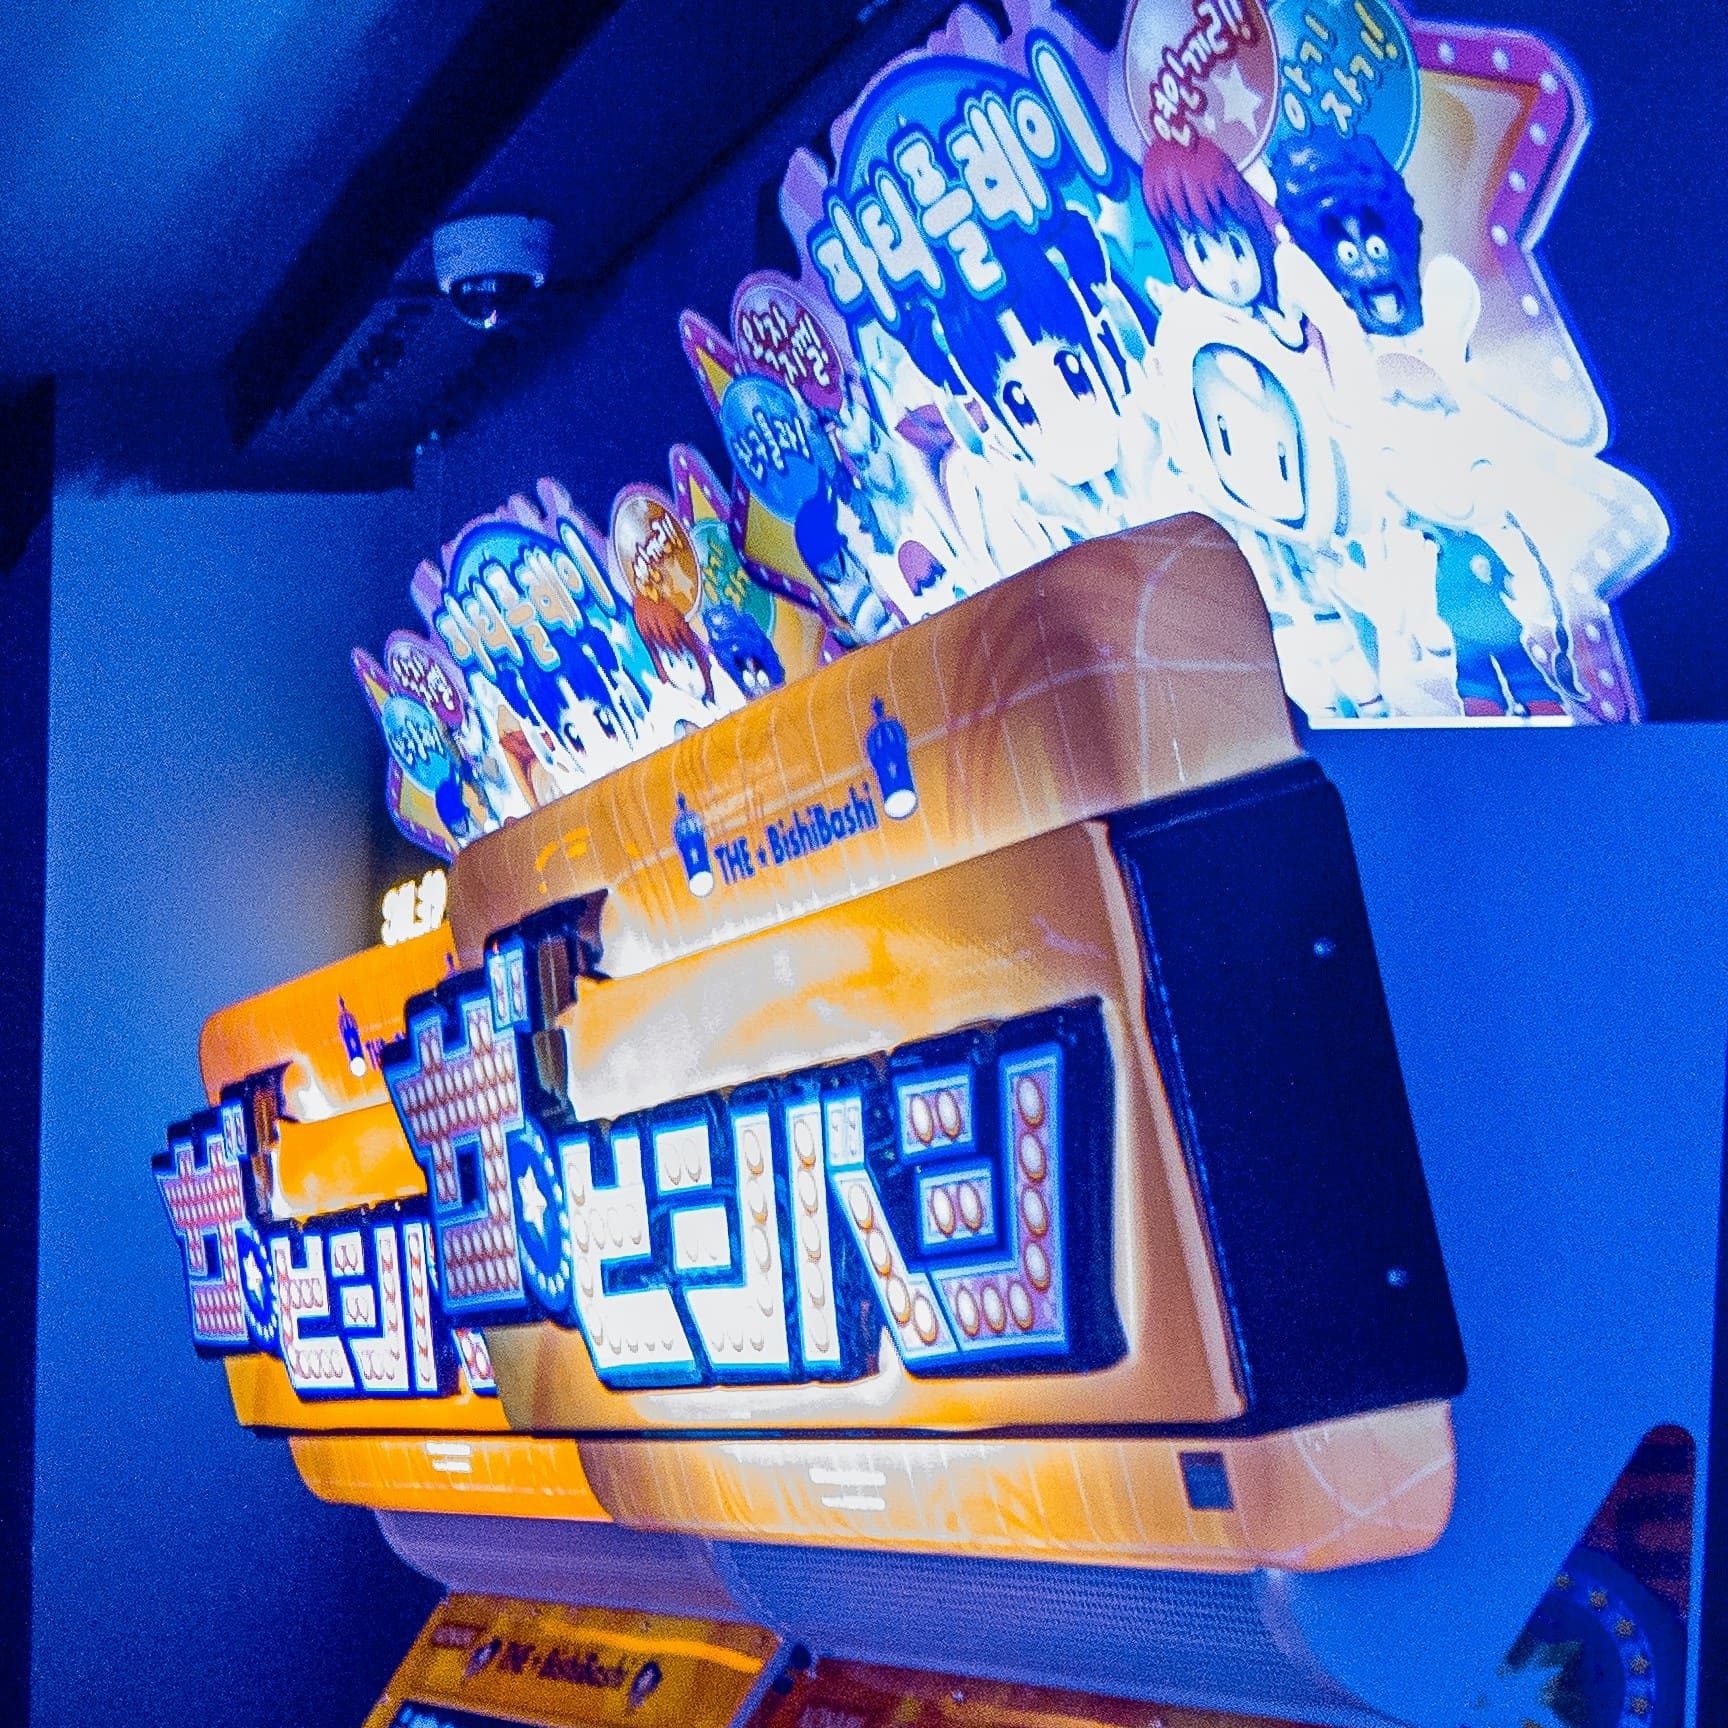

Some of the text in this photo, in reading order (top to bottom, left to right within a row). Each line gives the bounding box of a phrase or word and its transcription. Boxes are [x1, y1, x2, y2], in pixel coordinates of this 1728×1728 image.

[814, 38, 1114, 322] 파티플레이
[438, 518, 616, 680] 파티플레이
[713, 782, 879, 885] THE BishiBashi
